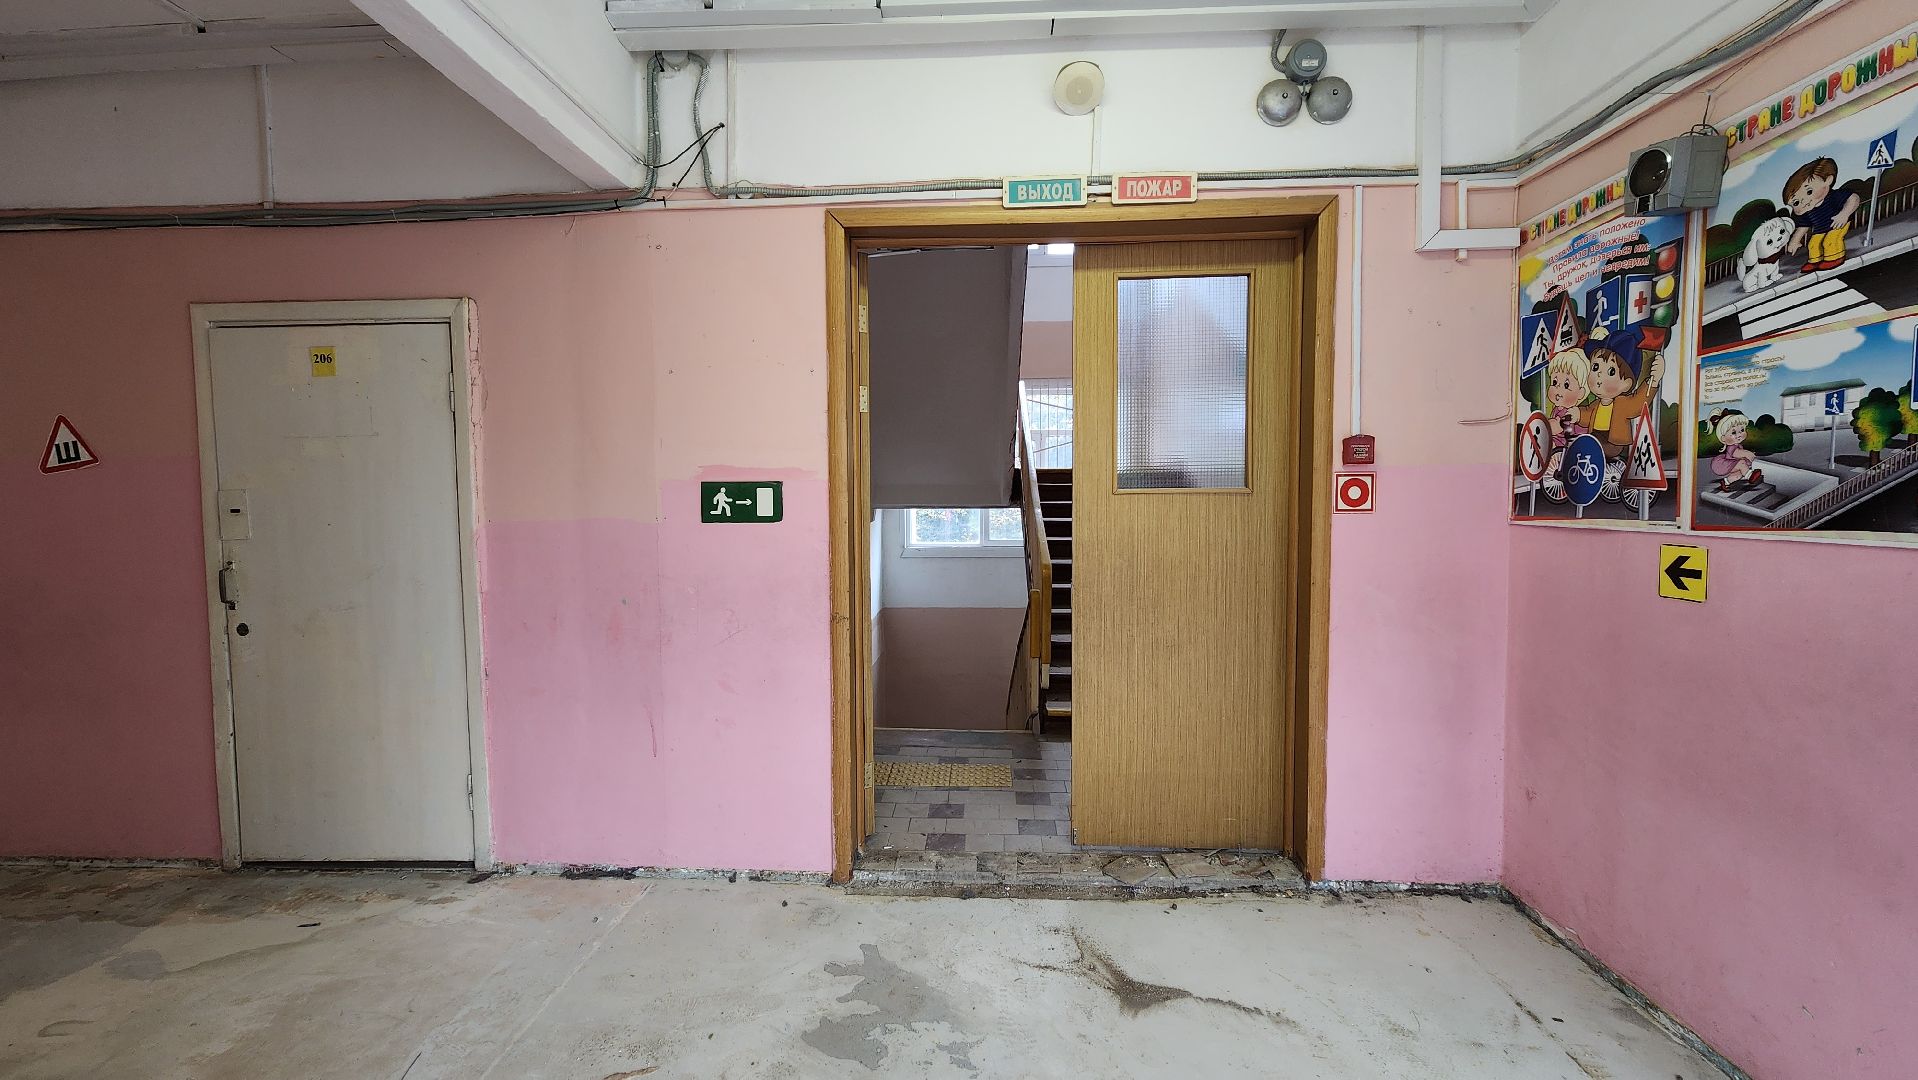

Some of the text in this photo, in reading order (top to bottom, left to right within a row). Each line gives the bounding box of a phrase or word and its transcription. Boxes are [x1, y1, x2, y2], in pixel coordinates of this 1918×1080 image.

[1725, 32, 1918, 148] СТРАНЕ ДОРОЖНЫ
[1017, 183, 1073, 201] ВЫХОД
[1126, 179, 1182, 197] ПОЖАР
[1567, 176, 1627, 226] ДОРОЖНЫ
[1600, 218, 1646, 237] положено
[1552, 250, 1588, 273] Правила
[1575, 271, 1590, 285] цел
[1591, 268, 1598, 277] и
[313, 353, 333, 364] 206
[55, 441, 81, 464] Ш
